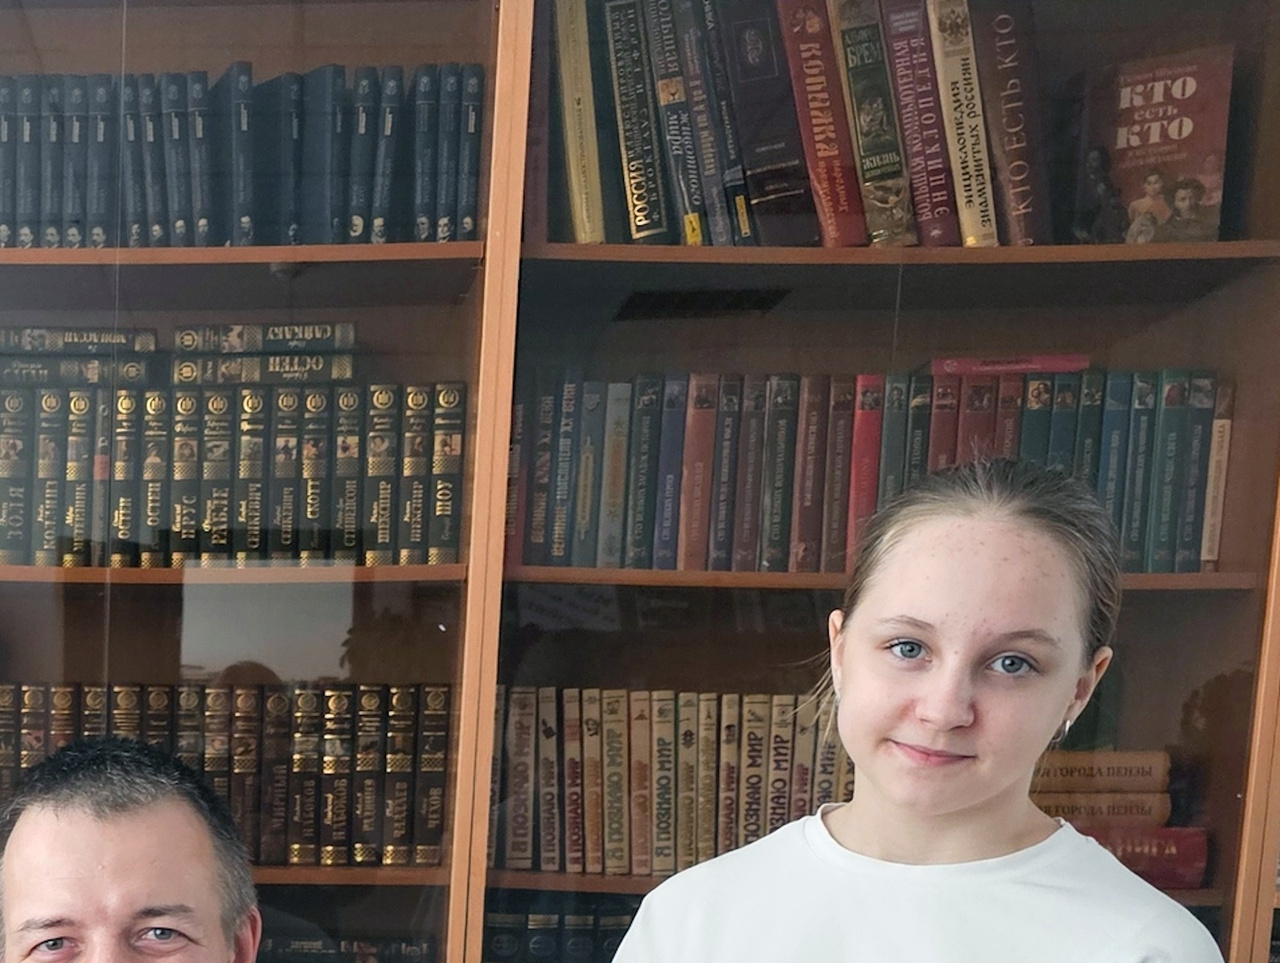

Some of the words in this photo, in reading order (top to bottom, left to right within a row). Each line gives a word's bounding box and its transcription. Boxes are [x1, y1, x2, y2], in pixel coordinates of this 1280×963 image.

[657, 0, 680, 73] ОЛЬШАЯ
[992, 12, 1018, 70] КТО
[799, 42, 840, 158] КОПИЛКА
[960, 56, 982, 120] РОССИЯН
[1118, 75, 1198, 110] КТО
[1000, 77, 1028, 152] ЕСТЬ
[1114, 116, 1194, 150] КТО
[1132, 105, 1179, 122] есть
[949, 79, 976, 210] ЭНЦИКЛОПЕДИЯ
[629, 157, 651, 227] РОССИЯ
[966, 119, 993, 228] ЗНАМЕНИТЫХ
[1010, 158, 1034, 218] КТО
[268, 354, 325, 372] ОСТЕН
[146, 482, 162, 527] ОСТЕН
[181, 495, 197, 540] ПРУС
[211, 487, 230, 545] РАБЛЕ
[306, 479, 320, 520] СКОТТ
[435, 479, 453, 517] ШОУ
[606, 727, 624, 768] МИР
[656, 736, 672, 773] МИР
[1106, 765, 1153, 779] ПЕНЗЫ
[655, 775, 673, 842] ПОЗНАЮ
[770, 778, 788, 833] ЗНАЮ
[1106, 804, 1153, 817] ПЕНЗЫ
